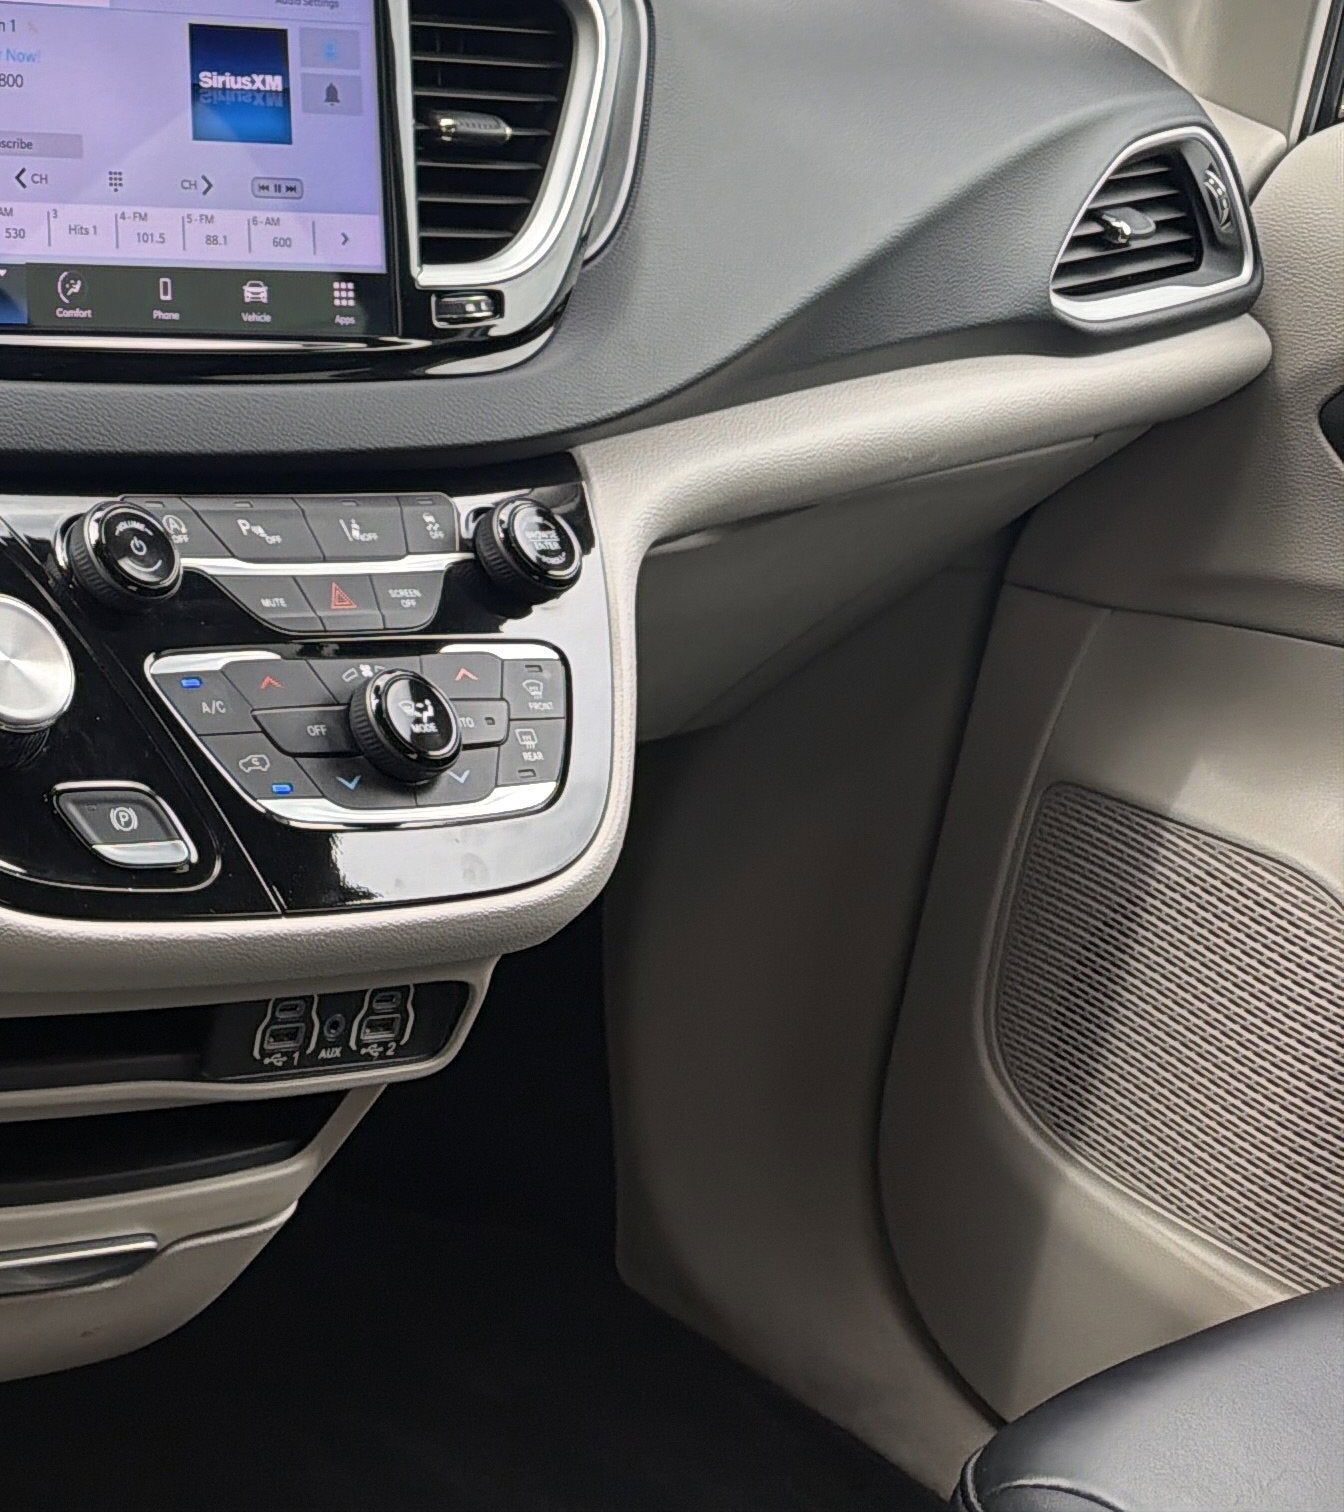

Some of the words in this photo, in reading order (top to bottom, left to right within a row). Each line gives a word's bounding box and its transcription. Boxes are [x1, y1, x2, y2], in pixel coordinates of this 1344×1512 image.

[11, 19, 17, 33] 1
[198, 70, 283, 92] SiriusXM
[30, 173, 48, 185] CH
[181, 179, 197, 190] CH
[52, 208, 58, 219] 3
[4, 227, 26, 239] 530
[68, 224, 90, 236] Hits
[136, 232, 166, 244] 101.5
[205, 235, 228, 246] 88.1
[272, 237, 292, 248] 600
[55, 307, 92, 318] Comfort
[153, 310, 180, 321] Phone
[241, 312, 272, 323] Vehicle
[334, 315, 355, 326] Apps
[388, 588, 422, 598] SCREEN
[260, 597, 288, 609] MUTE
[400, 598, 417, 608] OFF
[201, 700, 226, 715] A/C
[528, 700, 555, 711] FRONT
[307, 724, 328, 738] OFF
[411, 722, 439, 733] MODE
[522, 751, 545, 762] REAR
[317, 1046, 343, 1059] AUX
[385, 1041, 397, 1056] 2
[292, 1051, 300, 1066] 1
